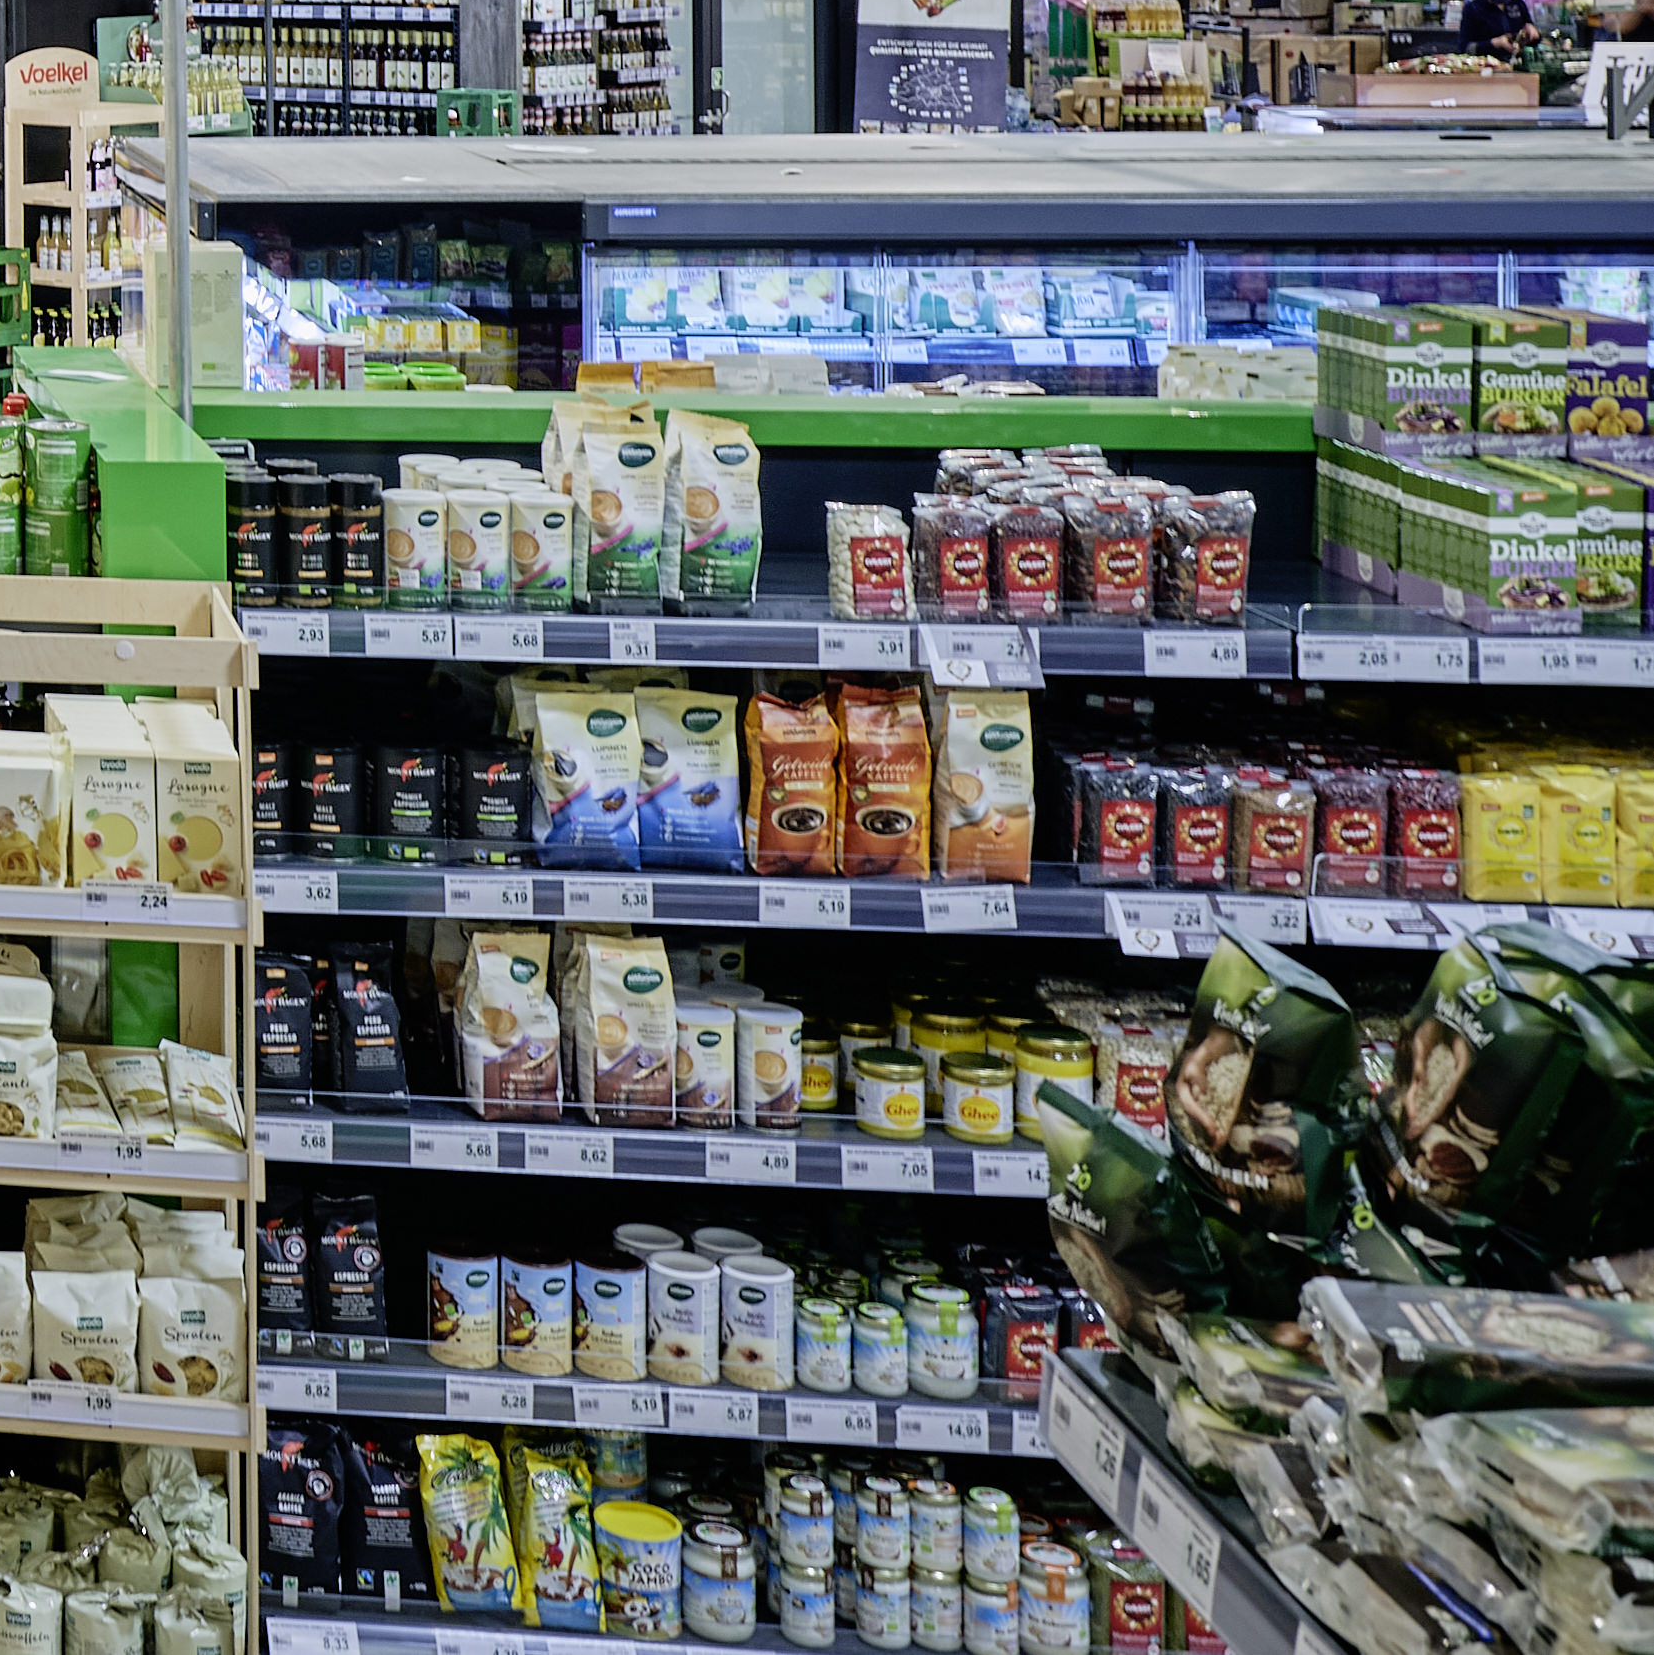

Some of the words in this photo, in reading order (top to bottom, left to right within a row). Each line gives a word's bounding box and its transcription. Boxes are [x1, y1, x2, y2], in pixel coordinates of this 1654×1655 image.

[20, 60, 88, 85] Voelkel
[1387, 367, 1472, 389] Dinkel
[1481, 368, 1566, 389] Gemüse
[1388, 388, 1470, 404] BURGER
[1481, 388, 1565, 406] BURGER
[1490, 539, 1576, 562] Dinkel
[1491, 561, 1576, 578] BURGER
[298, 628, 325, 643] 2,93
[422, 629, 448, 644] 5,87
[512, 633, 539, 649] 5,68
[624, 643, 650, 658] 9,31
[877, 640, 905, 654] 3,91
[1210, 646, 1240, 661] 4,89
[1358, 651, 1389, 667] 2,05
[1435, 653, 1464, 668] 1,75
[1539, 654, 1571, 669] 1,95
[82, 775, 145, 793] Lasagne
[166, 778, 230, 796] Lasagne
[306, 887, 331, 900] 3,62
[502, 892, 528, 904] 5,19
[621, 892, 647, 907] 5,38
[140, 894, 168, 909] 2,24
[817, 899, 845, 914] 5,19
[981, 901, 1010, 916] 7,64
[1174, 914, 1201, 927] 2,24
[1271, 915, 1299, 928] 3,22
[887, 1103, 919, 1117] Ghee
[960, 1105, 999, 1120] Ghee
[301, 1135, 327, 1148] 5,68
[115, 1145, 142, 1160] 1,95
[465, 1144, 492, 1157] 5,68
[580, 1148, 607, 1163] 8,62
[762, 1156, 789, 1170] 4,89
[900, 1163, 928, 1177] 7,05
[305, 1384, 330, 1398] 8,82
[84, 1395, 112, 1410] 1,95
[501, 1395, 527, 1408] 5,28
[631, 1399, 657, 1412] 5,19
[727, 1408, 753, 1420] 5,87
[844, 1416, 873, 1431] 6,85
[947, 1424, 982, 1439] 14,99
[633, 1562, 670, 1577] COCO
[629, 1572, 674, 1588] JAMBO
[322, 1635, 350, 1651] 8,33
